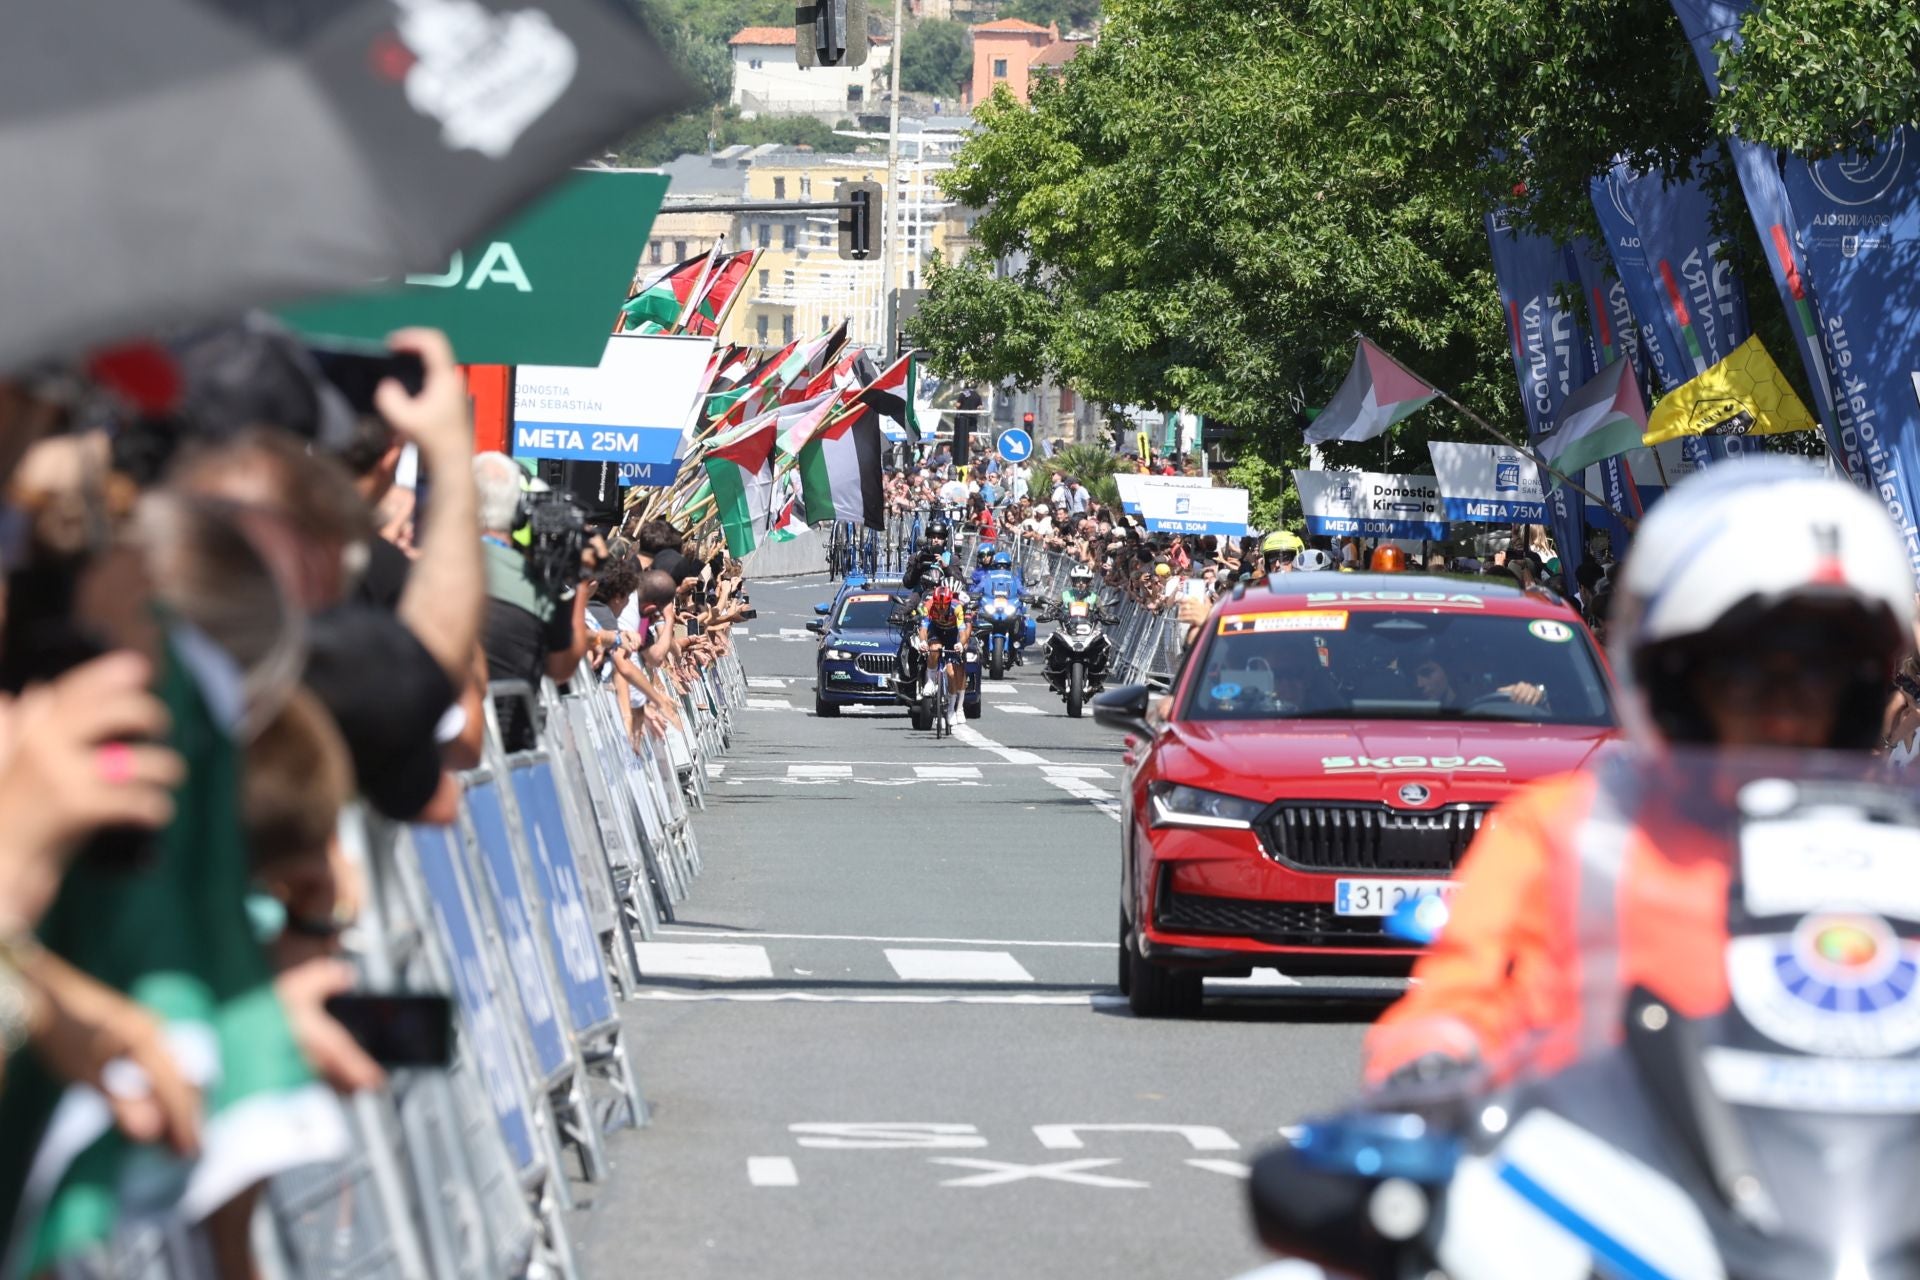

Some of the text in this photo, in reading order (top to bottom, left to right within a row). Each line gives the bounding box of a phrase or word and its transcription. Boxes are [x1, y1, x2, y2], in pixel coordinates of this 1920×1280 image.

[518, 428, 639, 452] META 25M
[1374, 485, 1436, 499] Donostia
[1466, 502, 1542, 519] META 75M
[1158, 520, 1183, 531] META
[1325, 519, 1394, 534] META 100M
